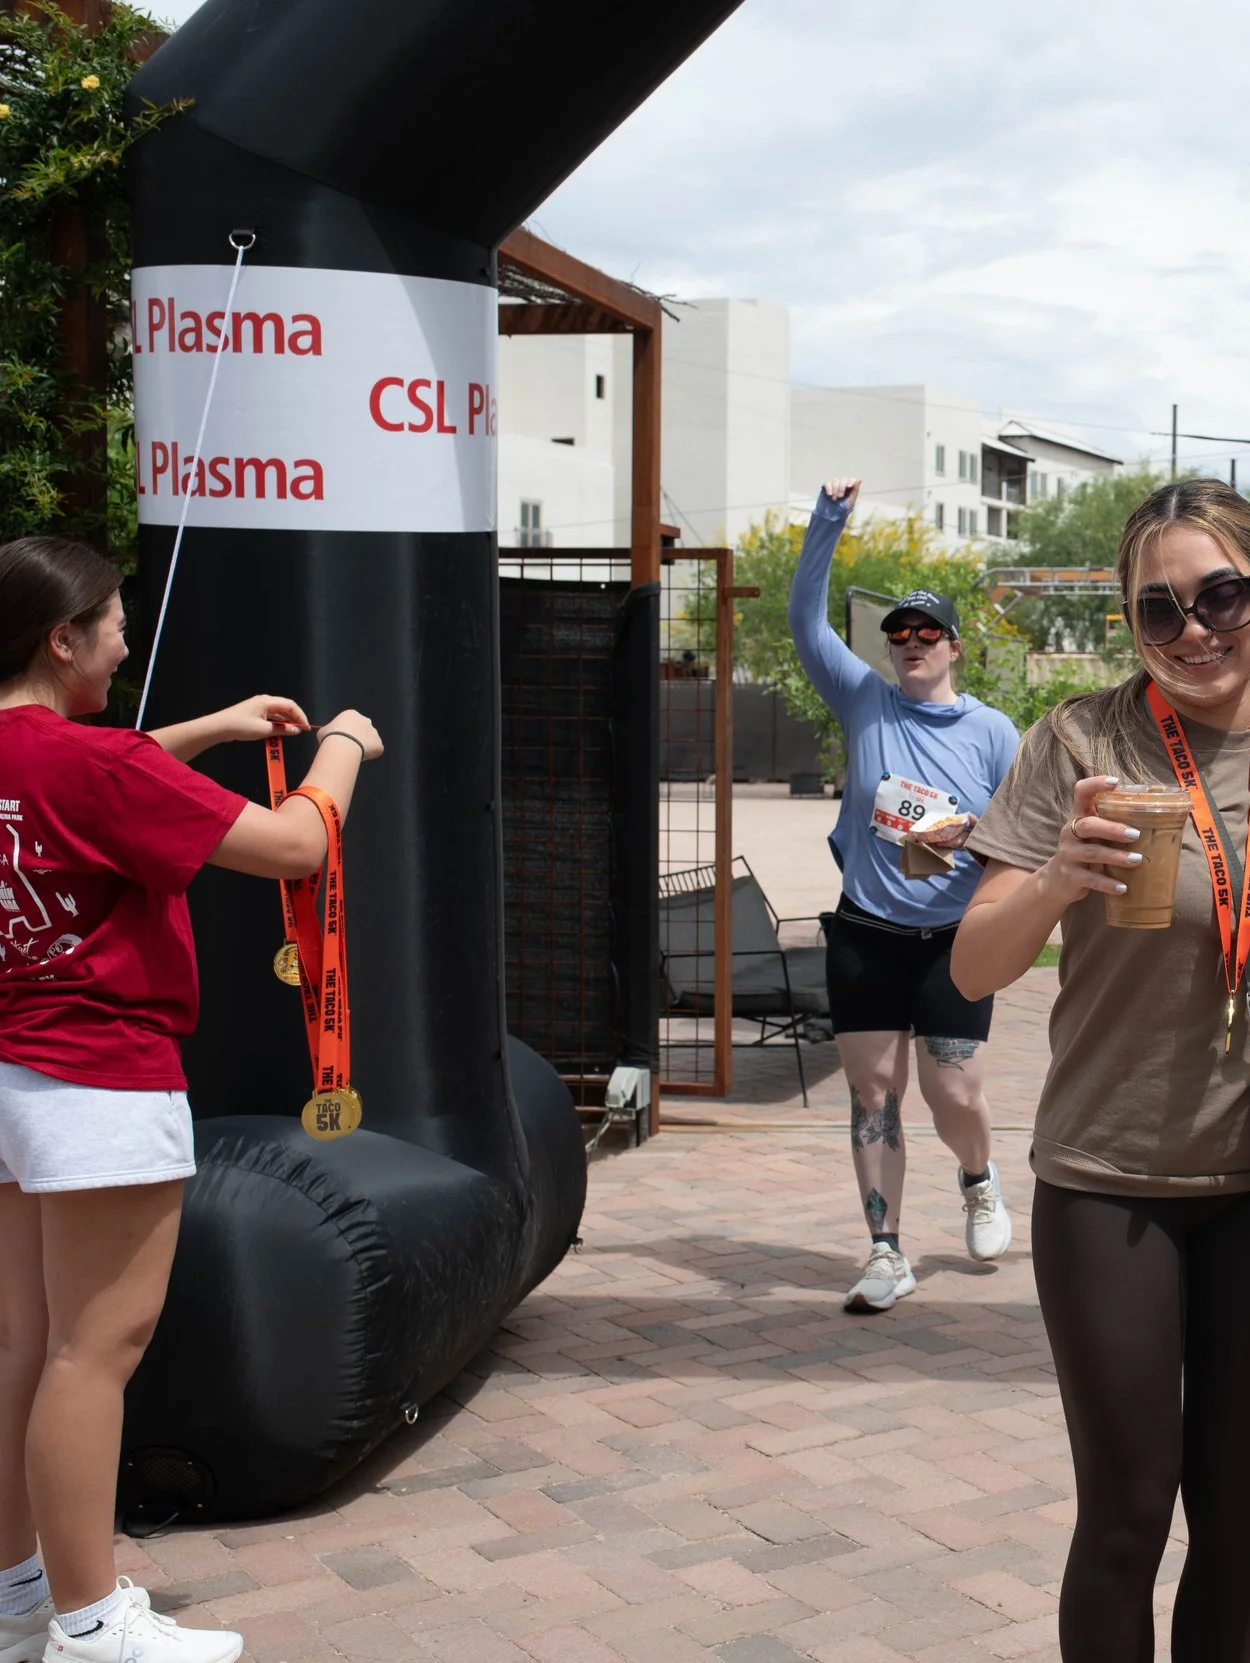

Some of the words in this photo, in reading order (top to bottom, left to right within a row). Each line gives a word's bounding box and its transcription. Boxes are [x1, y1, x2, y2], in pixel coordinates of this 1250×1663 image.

[148, 297, 322, 356] Plasma
[369, 376, 457, 434] CSL
[151, 441, 324, 501] Plasma
[1160, 714, 1179, 740] THE
[1169, 738, 1190, 770] TACO
[900, 780, 912, 791] THE
[1181, 770, 1197, 789] 5K
[898, 800, 926, 822] 89
[1202, 827, 1220, 852] THE
[329, 870, 337, 891] THE
[1210, 854, 1227, 886] TACO
[328, 892, 337, 918] TACO
[1218, 887, 1229, 907] 5K
[328, 920, 337, 935] 5K
[325, 968, 337, 989] THE
[306, 1002, 318, 1024] THE
[324, 991, 336, 1016] TACO
[323, 1018, 335, 1033] 5K
[321, 1065, 334, 1086] THE
[315, 1102, 341, 1114] TACO
[316, 1113, 341, 1132] 5K
